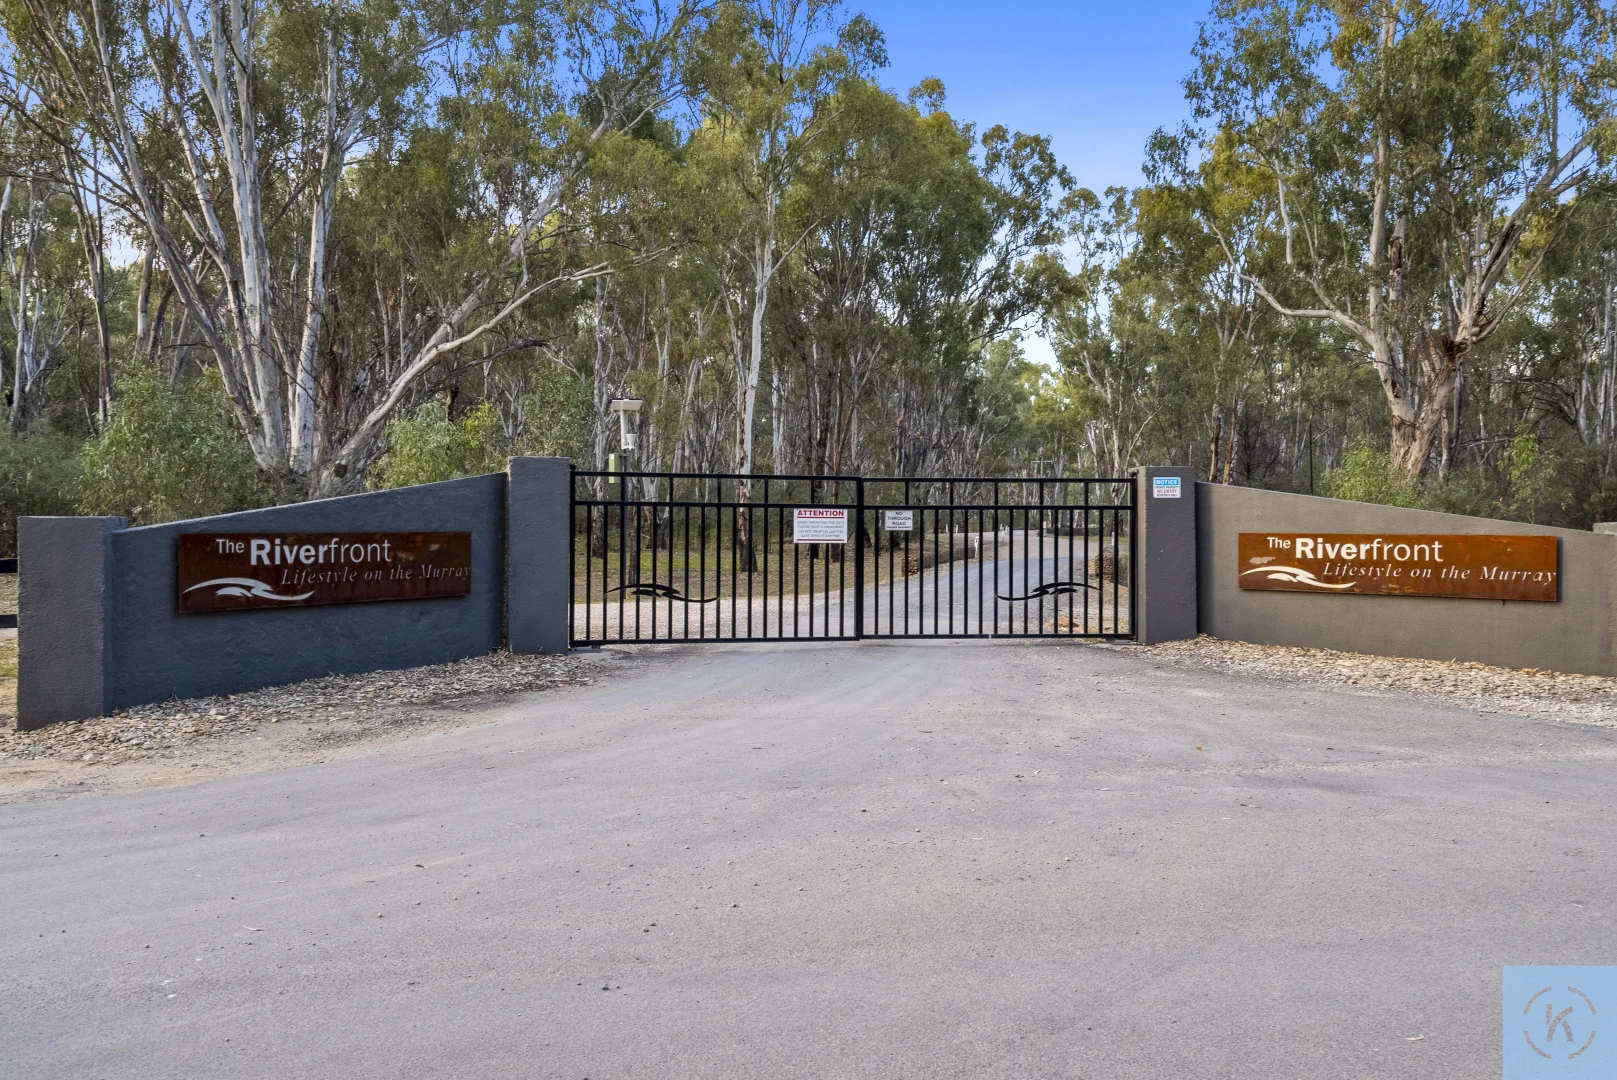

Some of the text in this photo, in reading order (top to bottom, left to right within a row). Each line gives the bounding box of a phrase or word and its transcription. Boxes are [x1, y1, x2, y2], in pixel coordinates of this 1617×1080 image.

[216, 538, 392, 566] The Riverfront
[1267, 537, 1444, 562] The Riverfront
[281, 564, 471, 587] Lifestyle on the Murray
[1323, 562, 1556, 586] Lifestyle on the Murray
